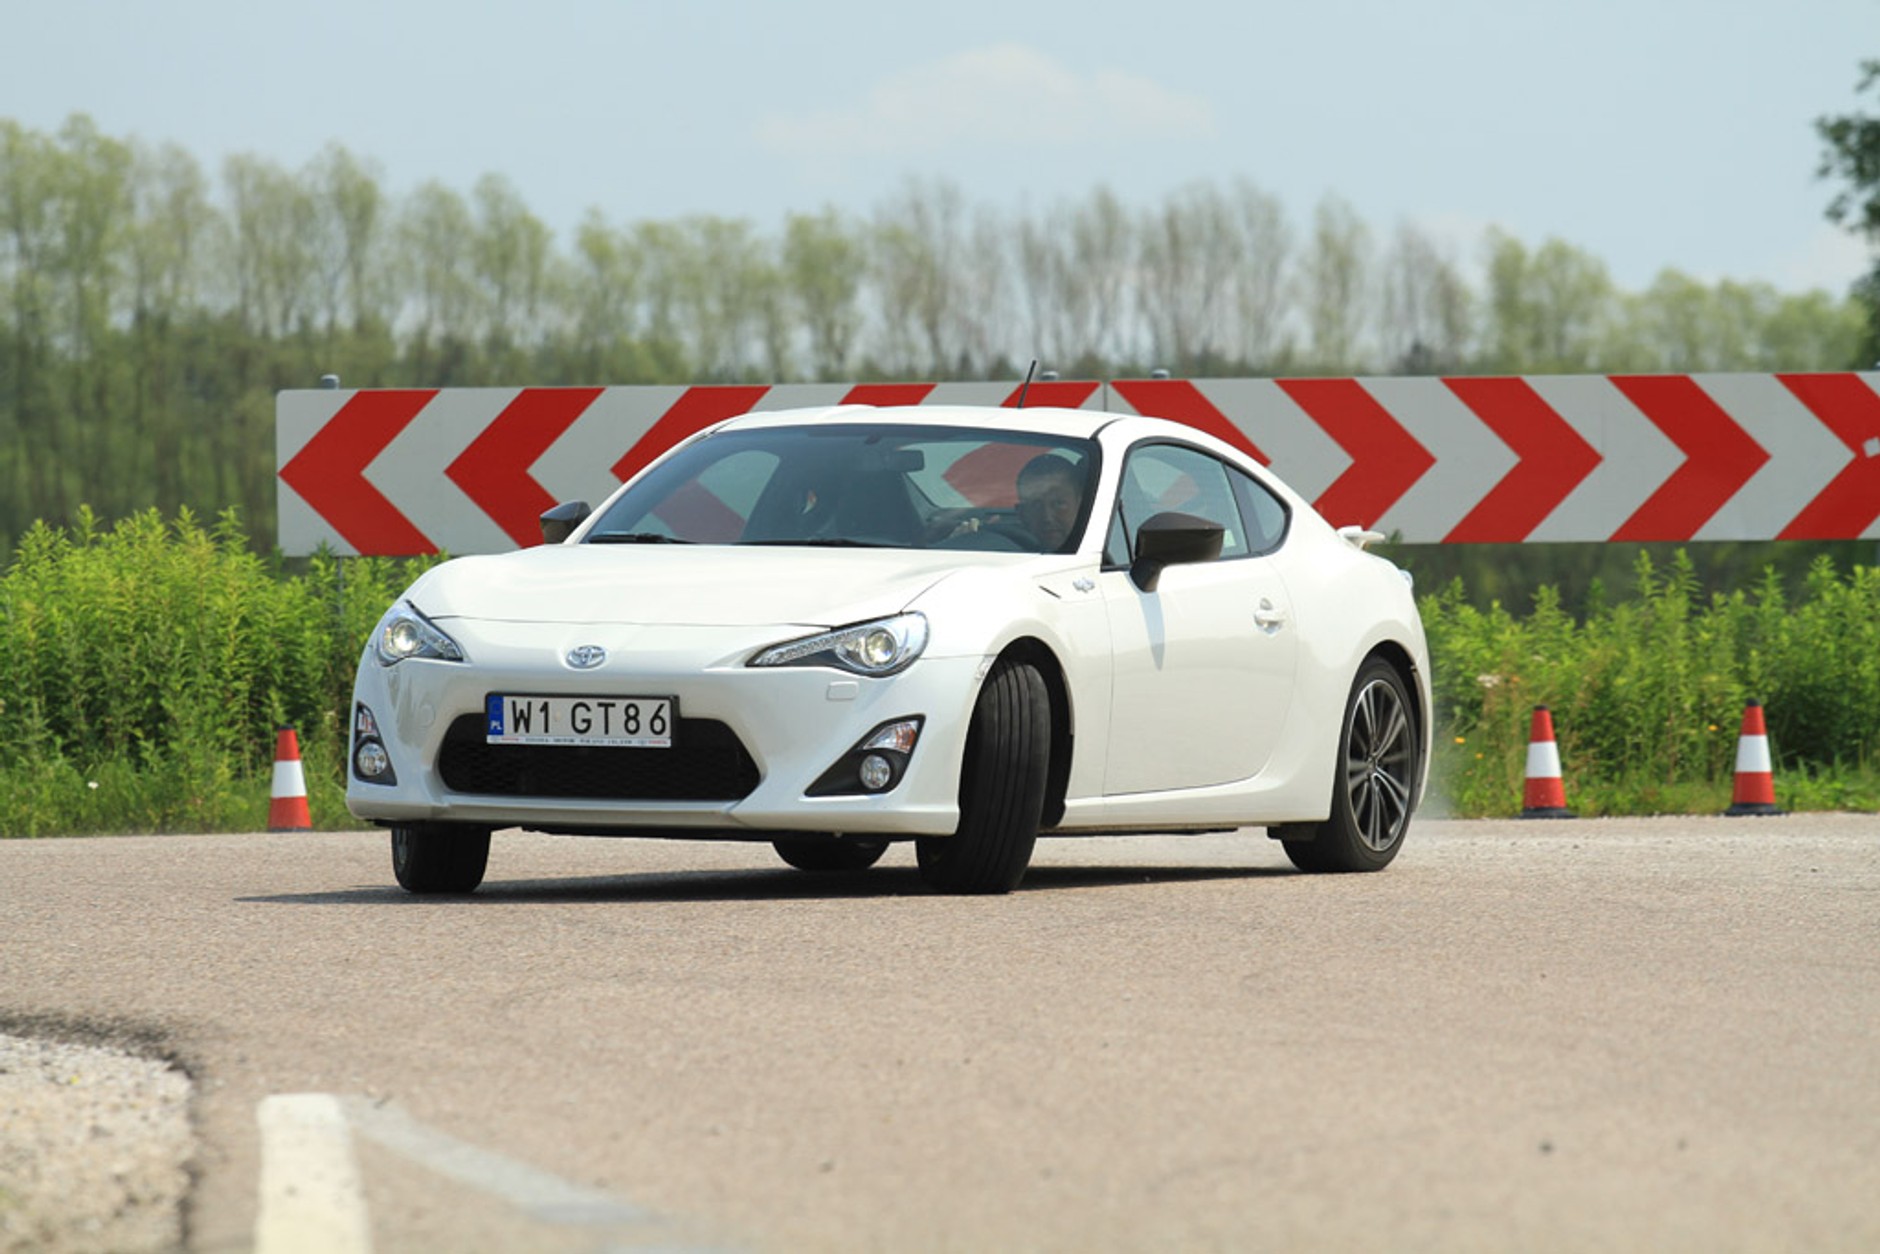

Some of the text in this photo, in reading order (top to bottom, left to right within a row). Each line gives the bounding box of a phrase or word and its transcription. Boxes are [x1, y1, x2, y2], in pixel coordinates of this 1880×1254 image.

[490, 720, 503, 731] PL
[511, 700, 667, 736] W1 GT86
